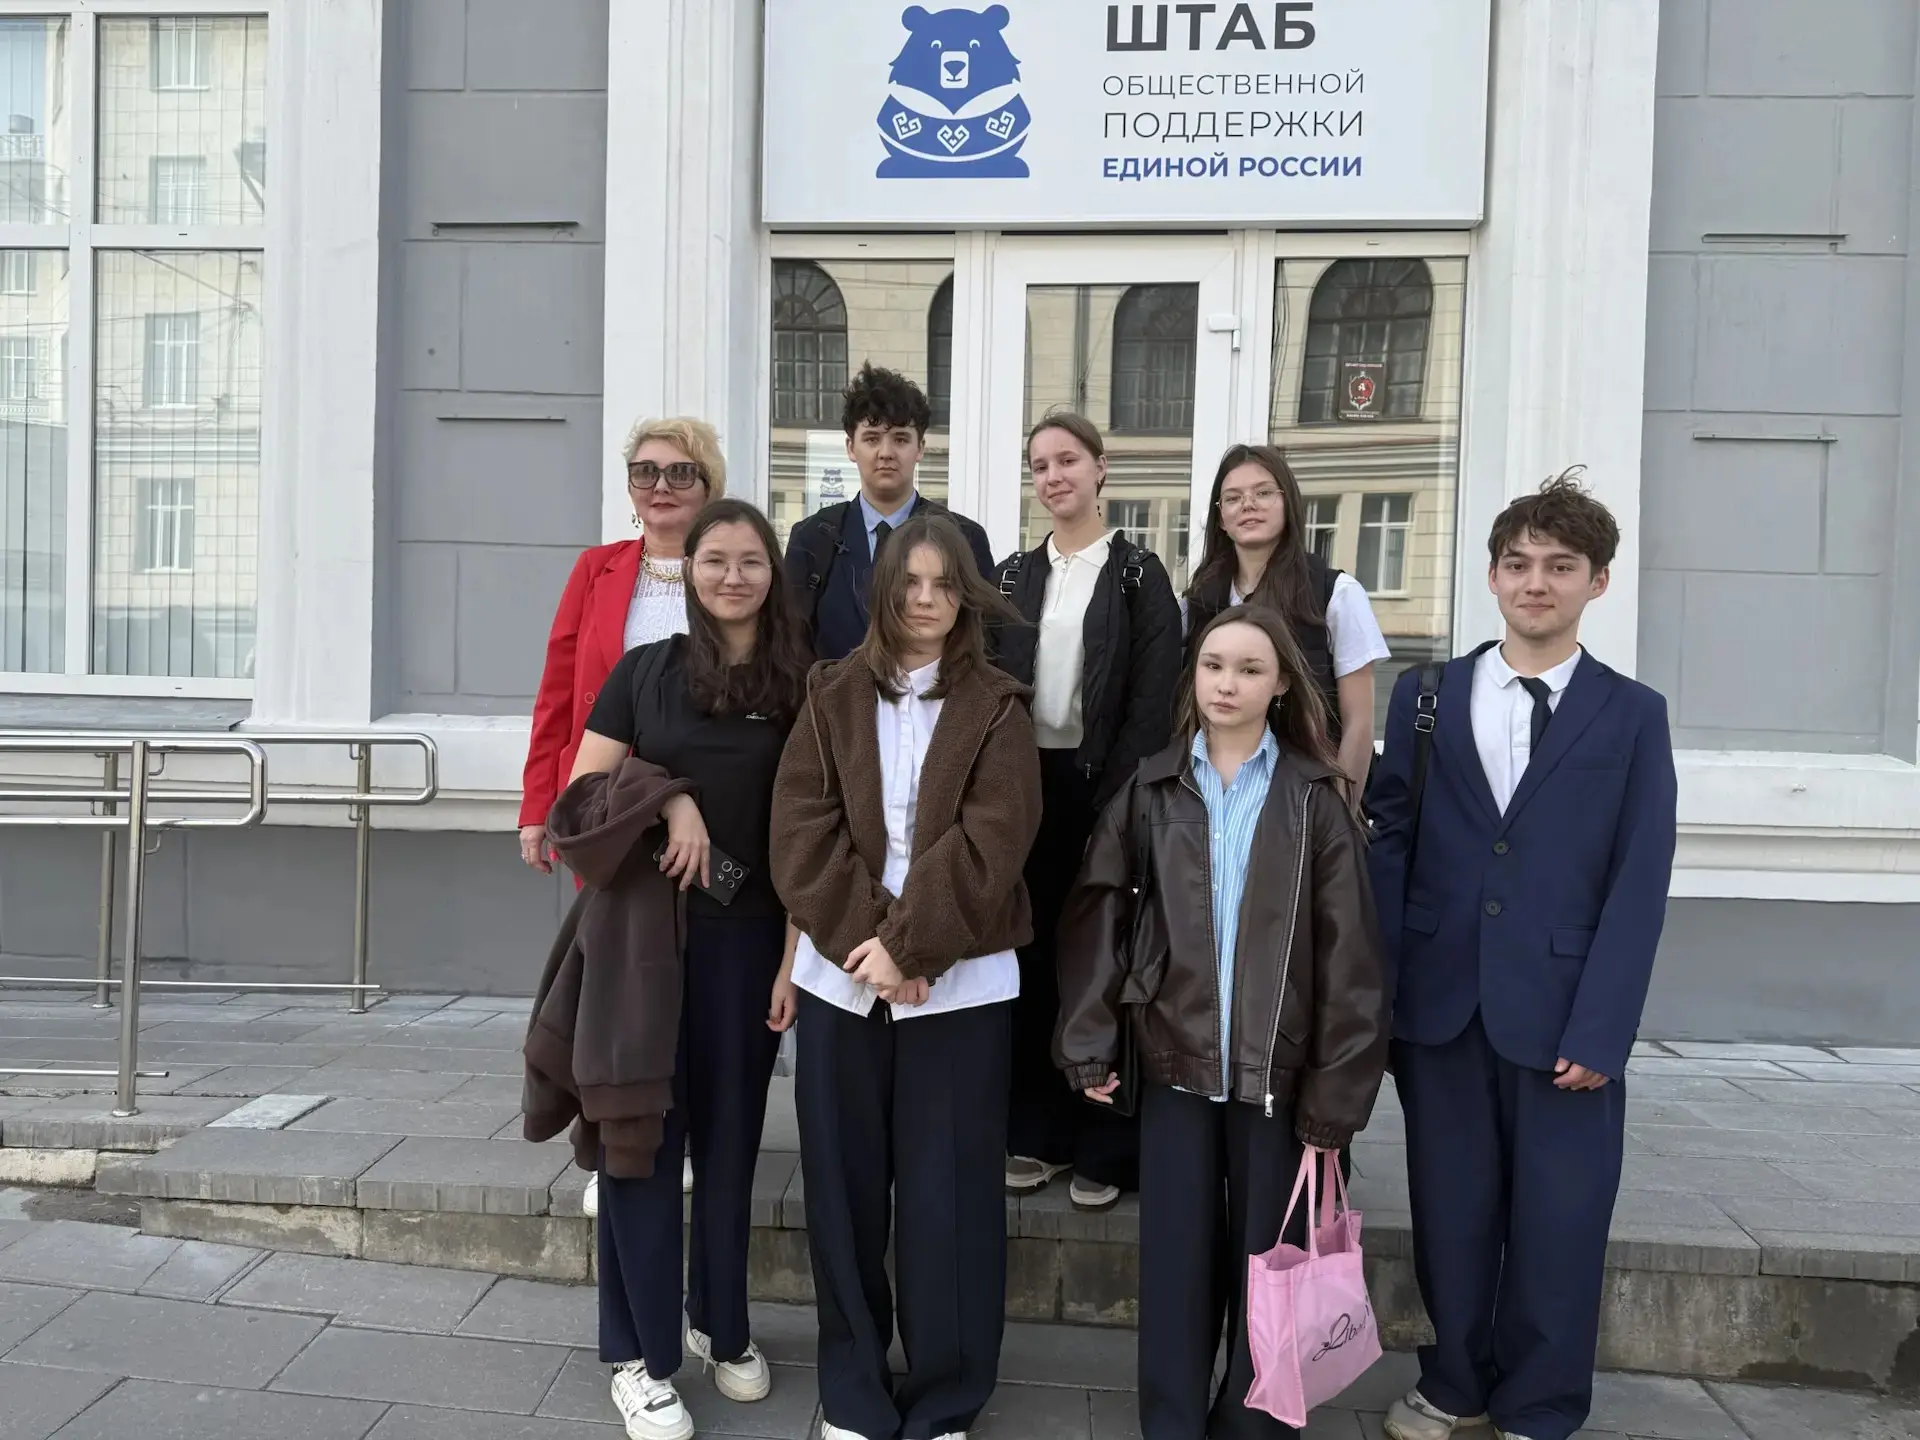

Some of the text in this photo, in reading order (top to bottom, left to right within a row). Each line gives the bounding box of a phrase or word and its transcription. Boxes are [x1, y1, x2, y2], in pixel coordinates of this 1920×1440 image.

[1106, 2, 1316, 51] ШТАБ
[1102, 68, 1364, 99] ОБЩЕСТВЕННОЙ
[1103, 110, 1363, 143] ПОДДЕРЖКИ
[1103, 151, 1362, 182] ЕДИНОЙ РОССИИ
